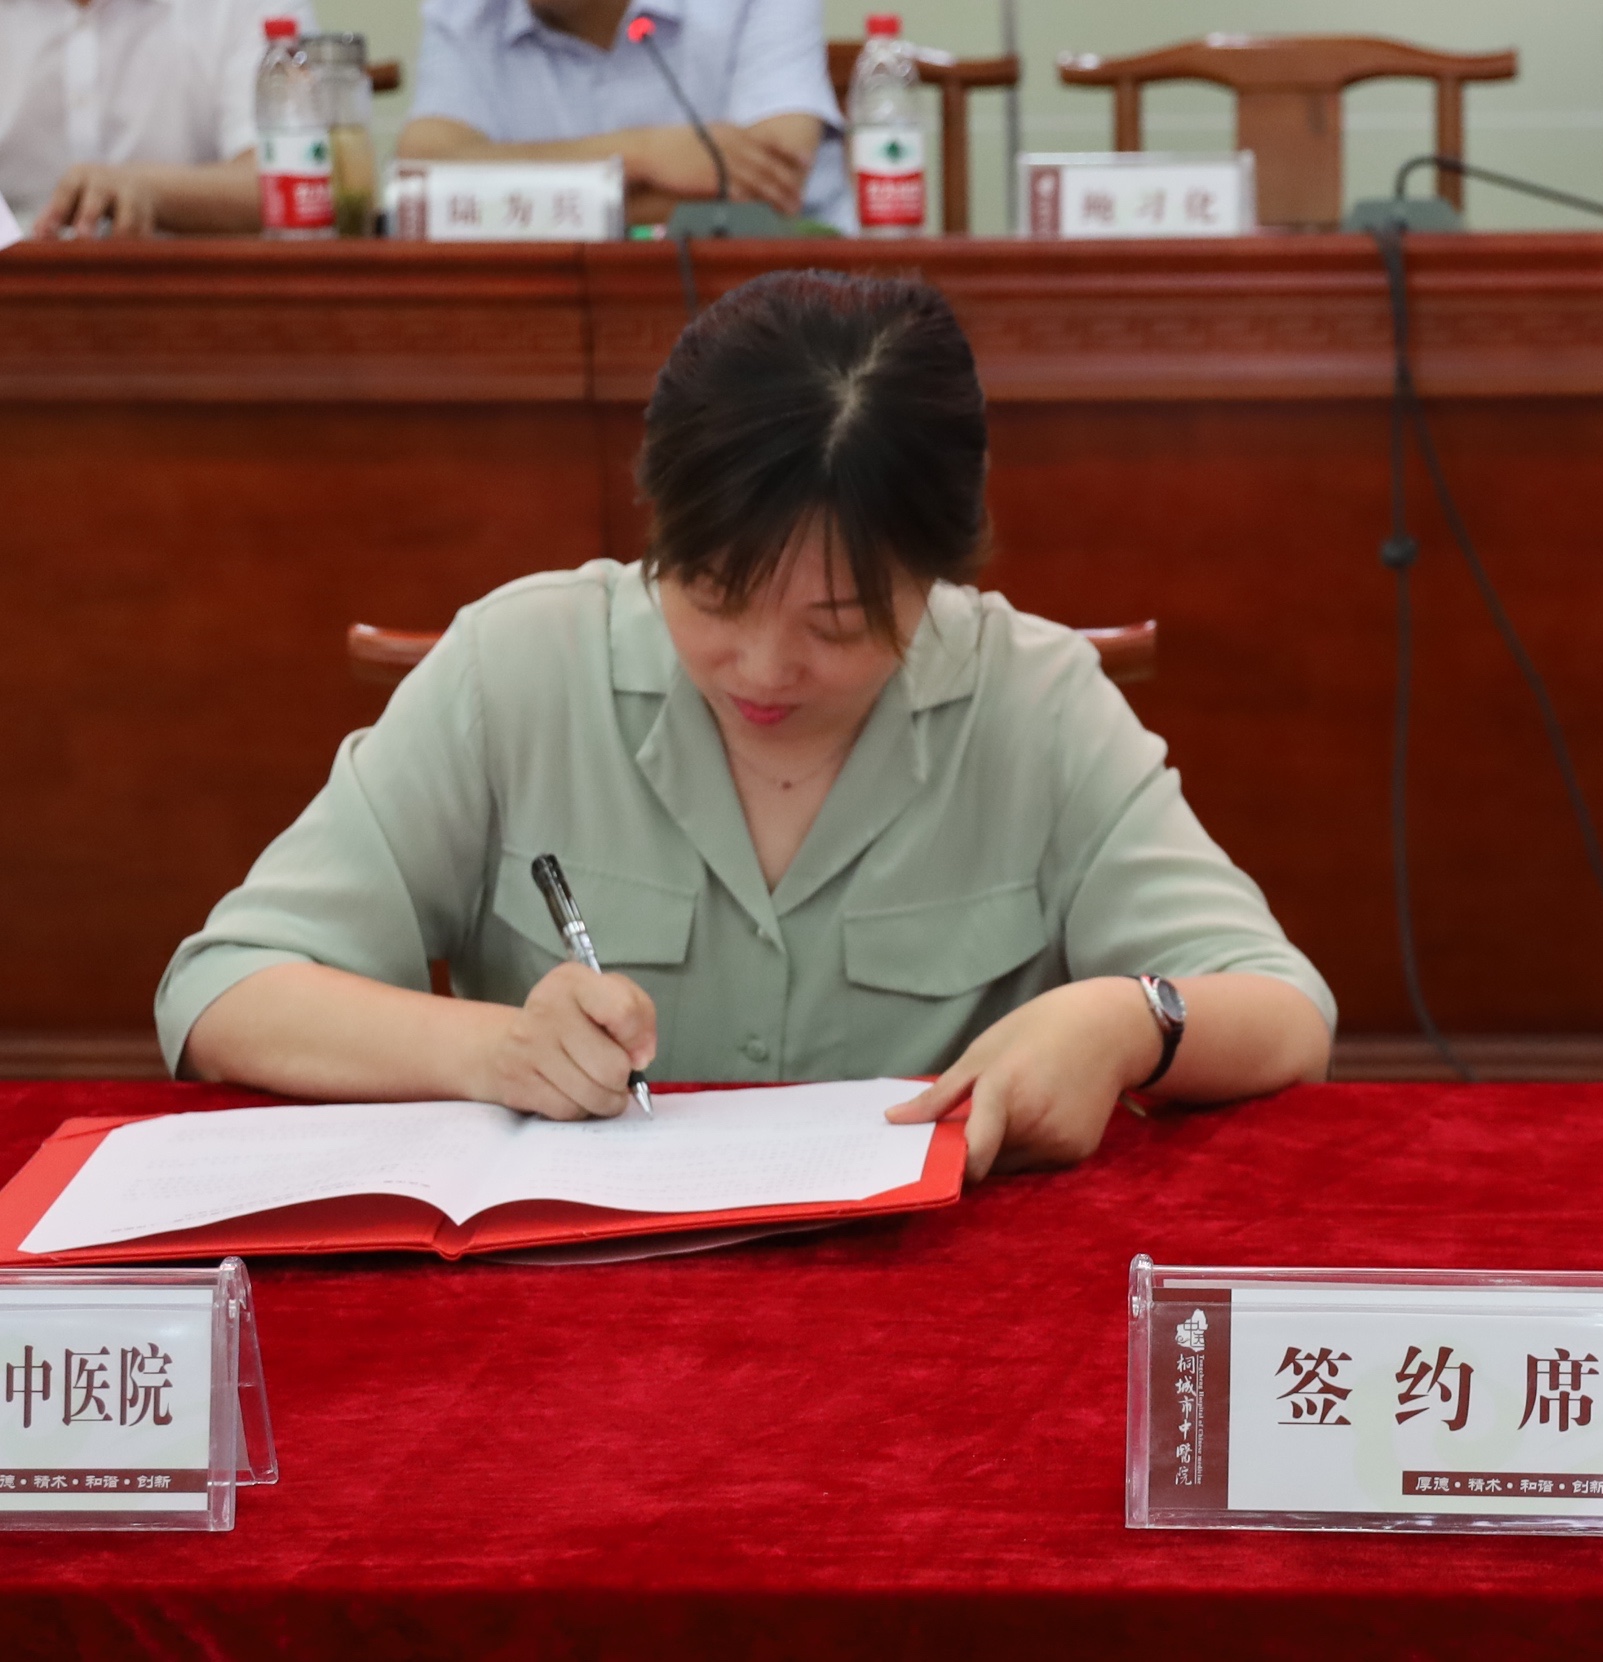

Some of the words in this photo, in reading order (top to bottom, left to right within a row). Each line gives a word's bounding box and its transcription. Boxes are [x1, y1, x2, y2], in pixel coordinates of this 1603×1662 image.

[5, 1342, 173, 1428] 中医院
[1276, 1345, 1600, 1433] 签约席
